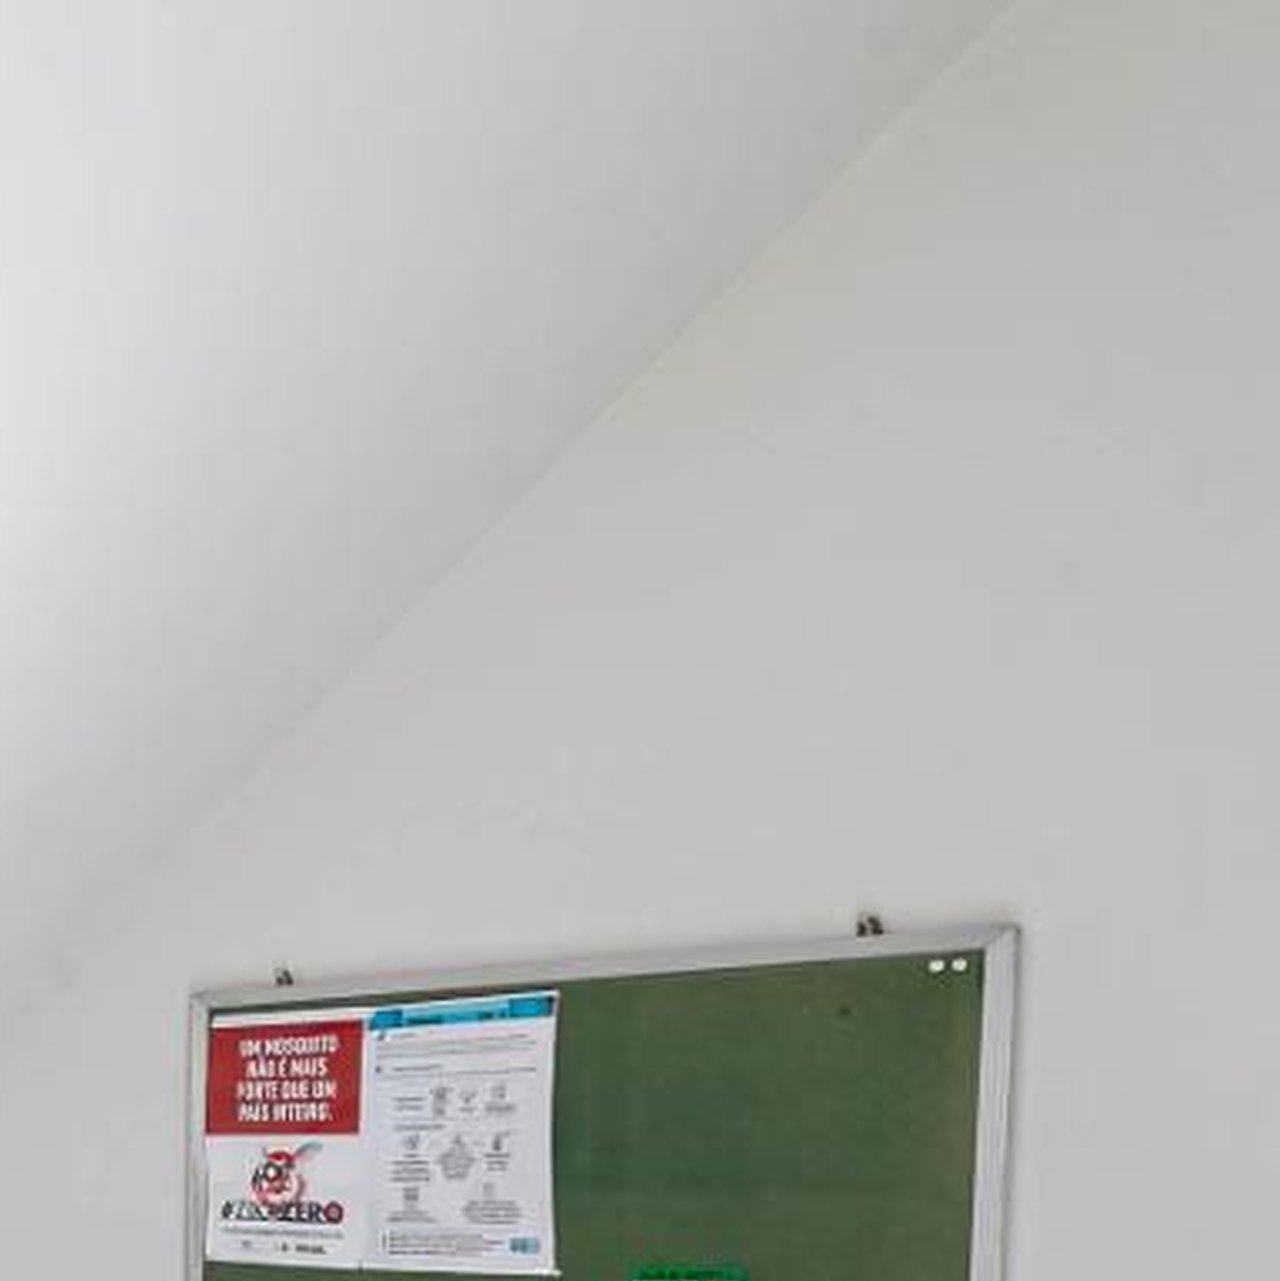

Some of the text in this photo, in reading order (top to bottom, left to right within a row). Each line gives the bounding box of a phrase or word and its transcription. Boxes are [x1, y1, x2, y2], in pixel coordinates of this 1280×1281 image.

[265, 1035, 339, 1055] MOSQUITO
[246, 1056, 275, 1077] NÃO
[290, 1058, 328, 1077] MAIS
[237, 1080, 337, 1099] FORTE QUE UM
